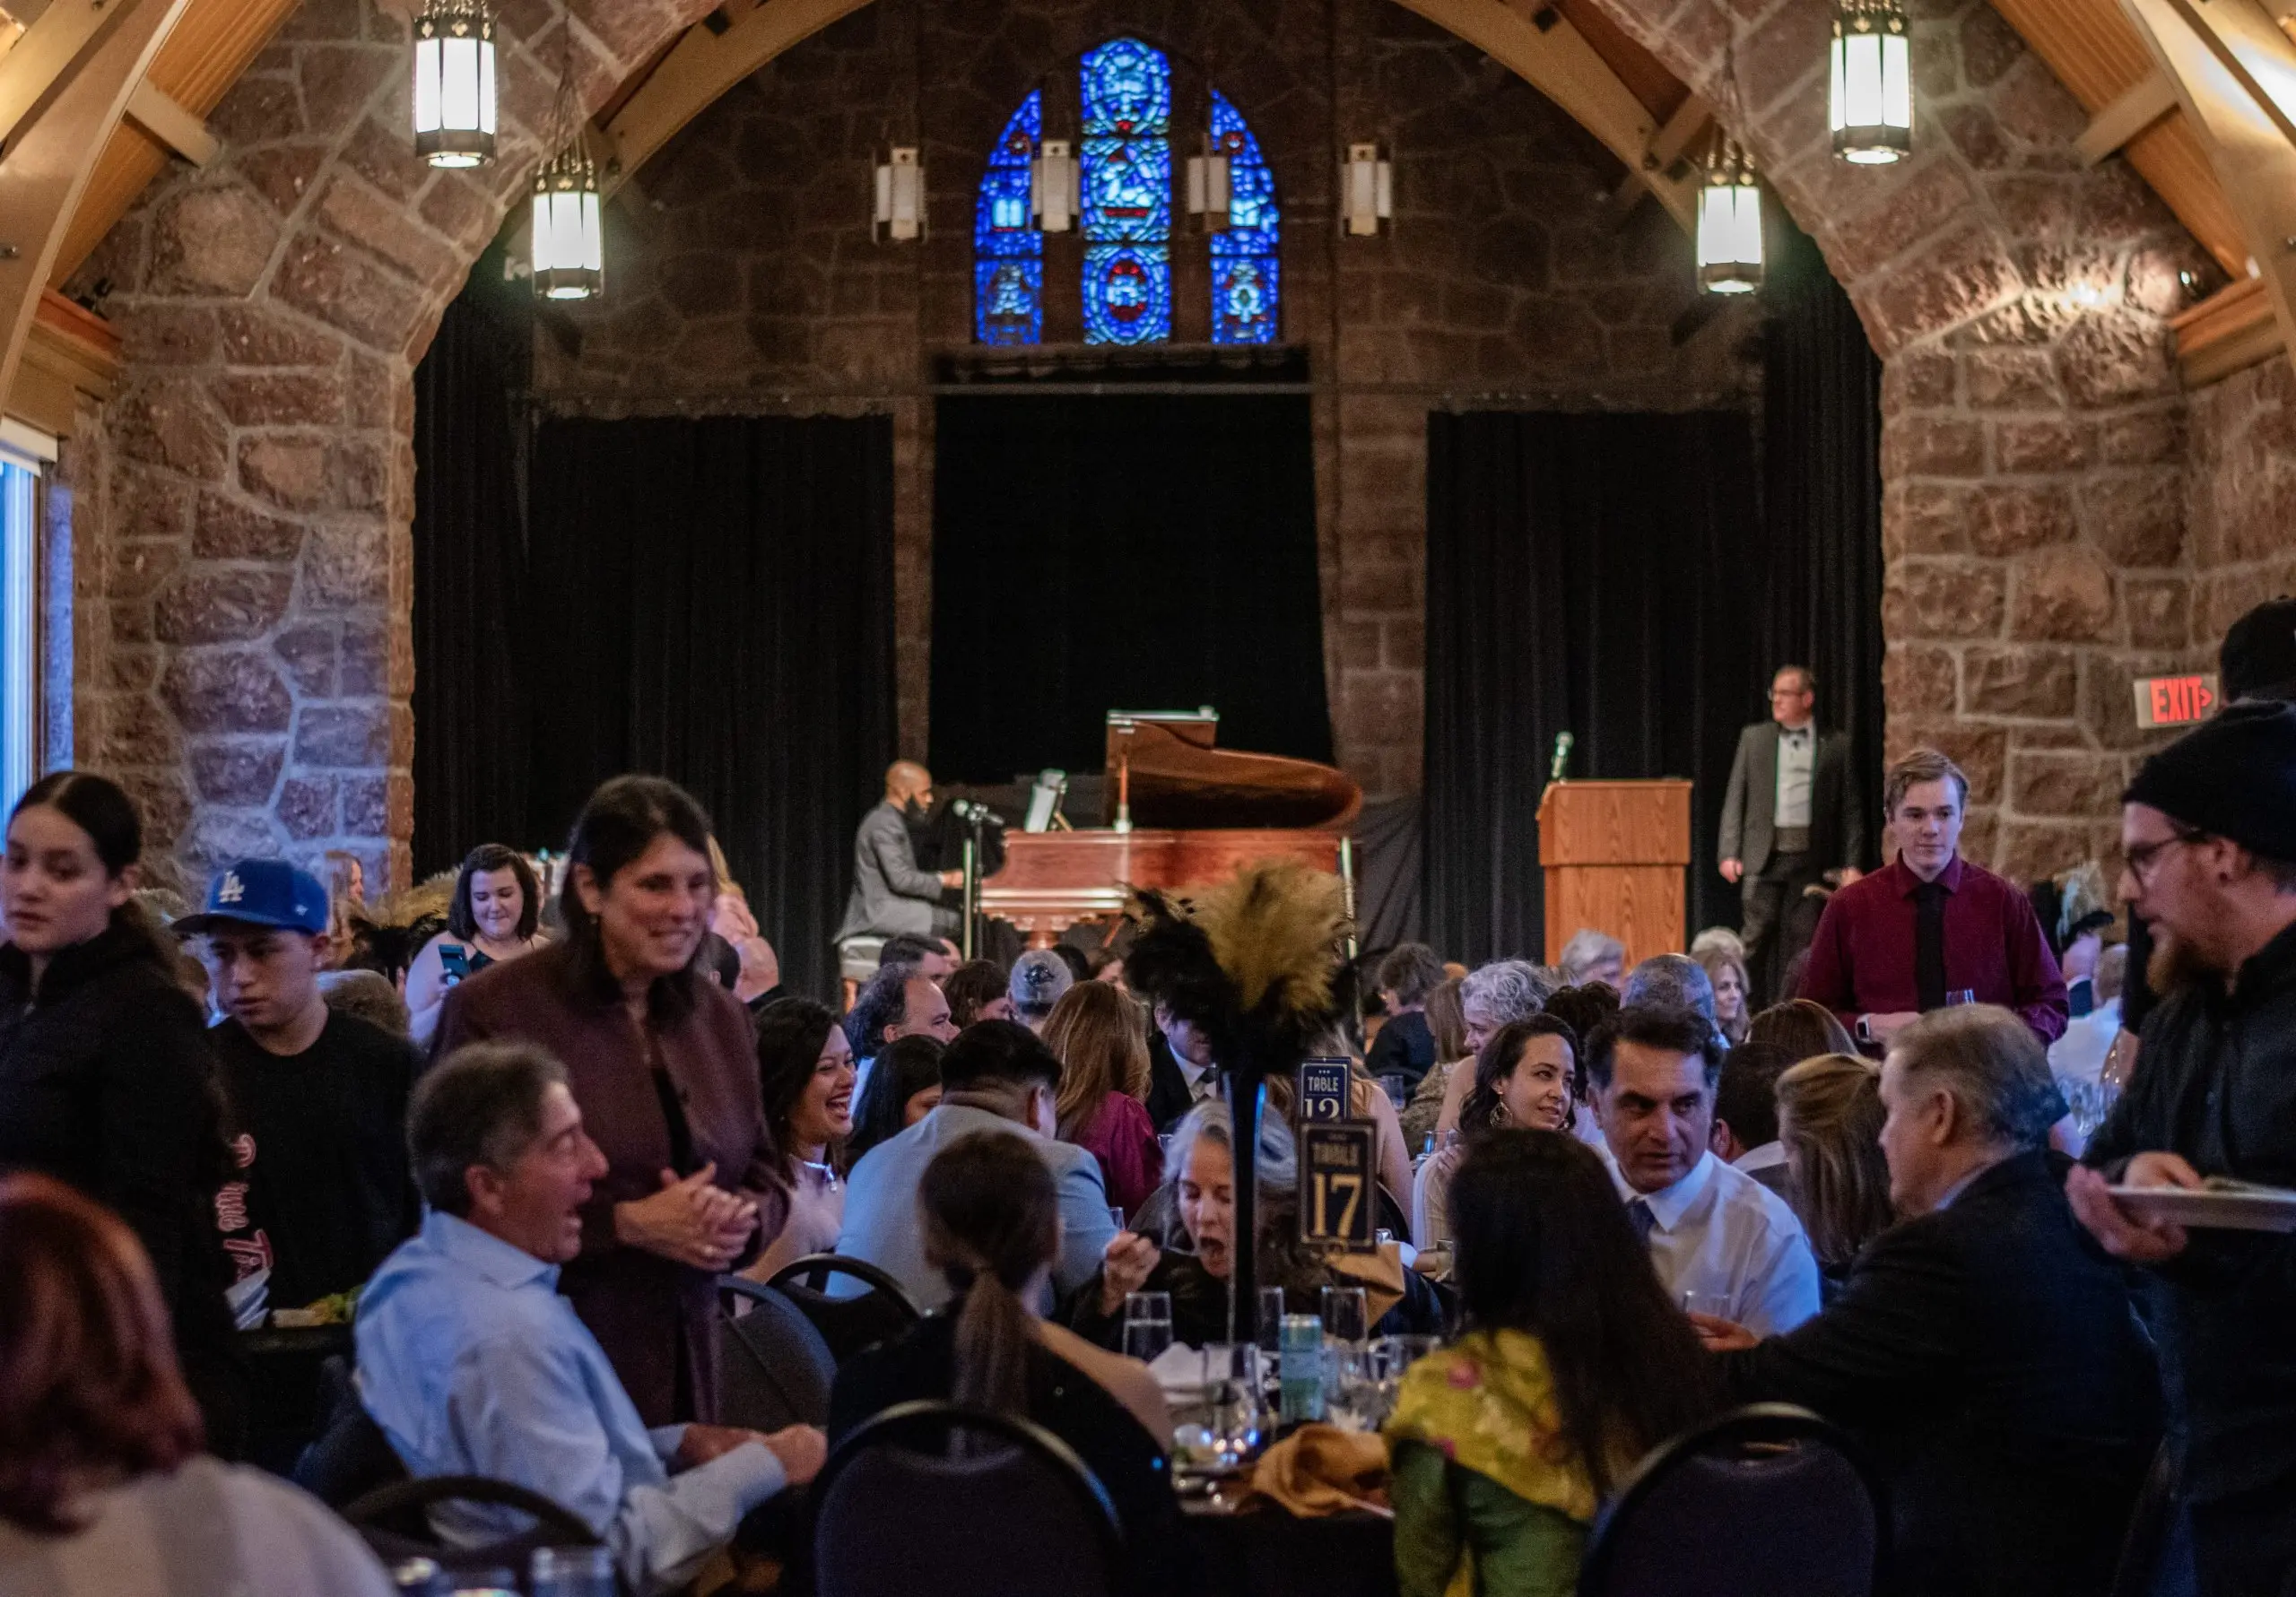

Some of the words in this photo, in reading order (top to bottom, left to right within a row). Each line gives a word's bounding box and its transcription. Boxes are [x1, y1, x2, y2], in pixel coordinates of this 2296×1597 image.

[2150, 677, 2203, 723] EXIT
[219, 871, 246, 903] LA
[1308, 1076, 1339, 1092] TABLE
[1314, 1174, 1361, 1237] 17
